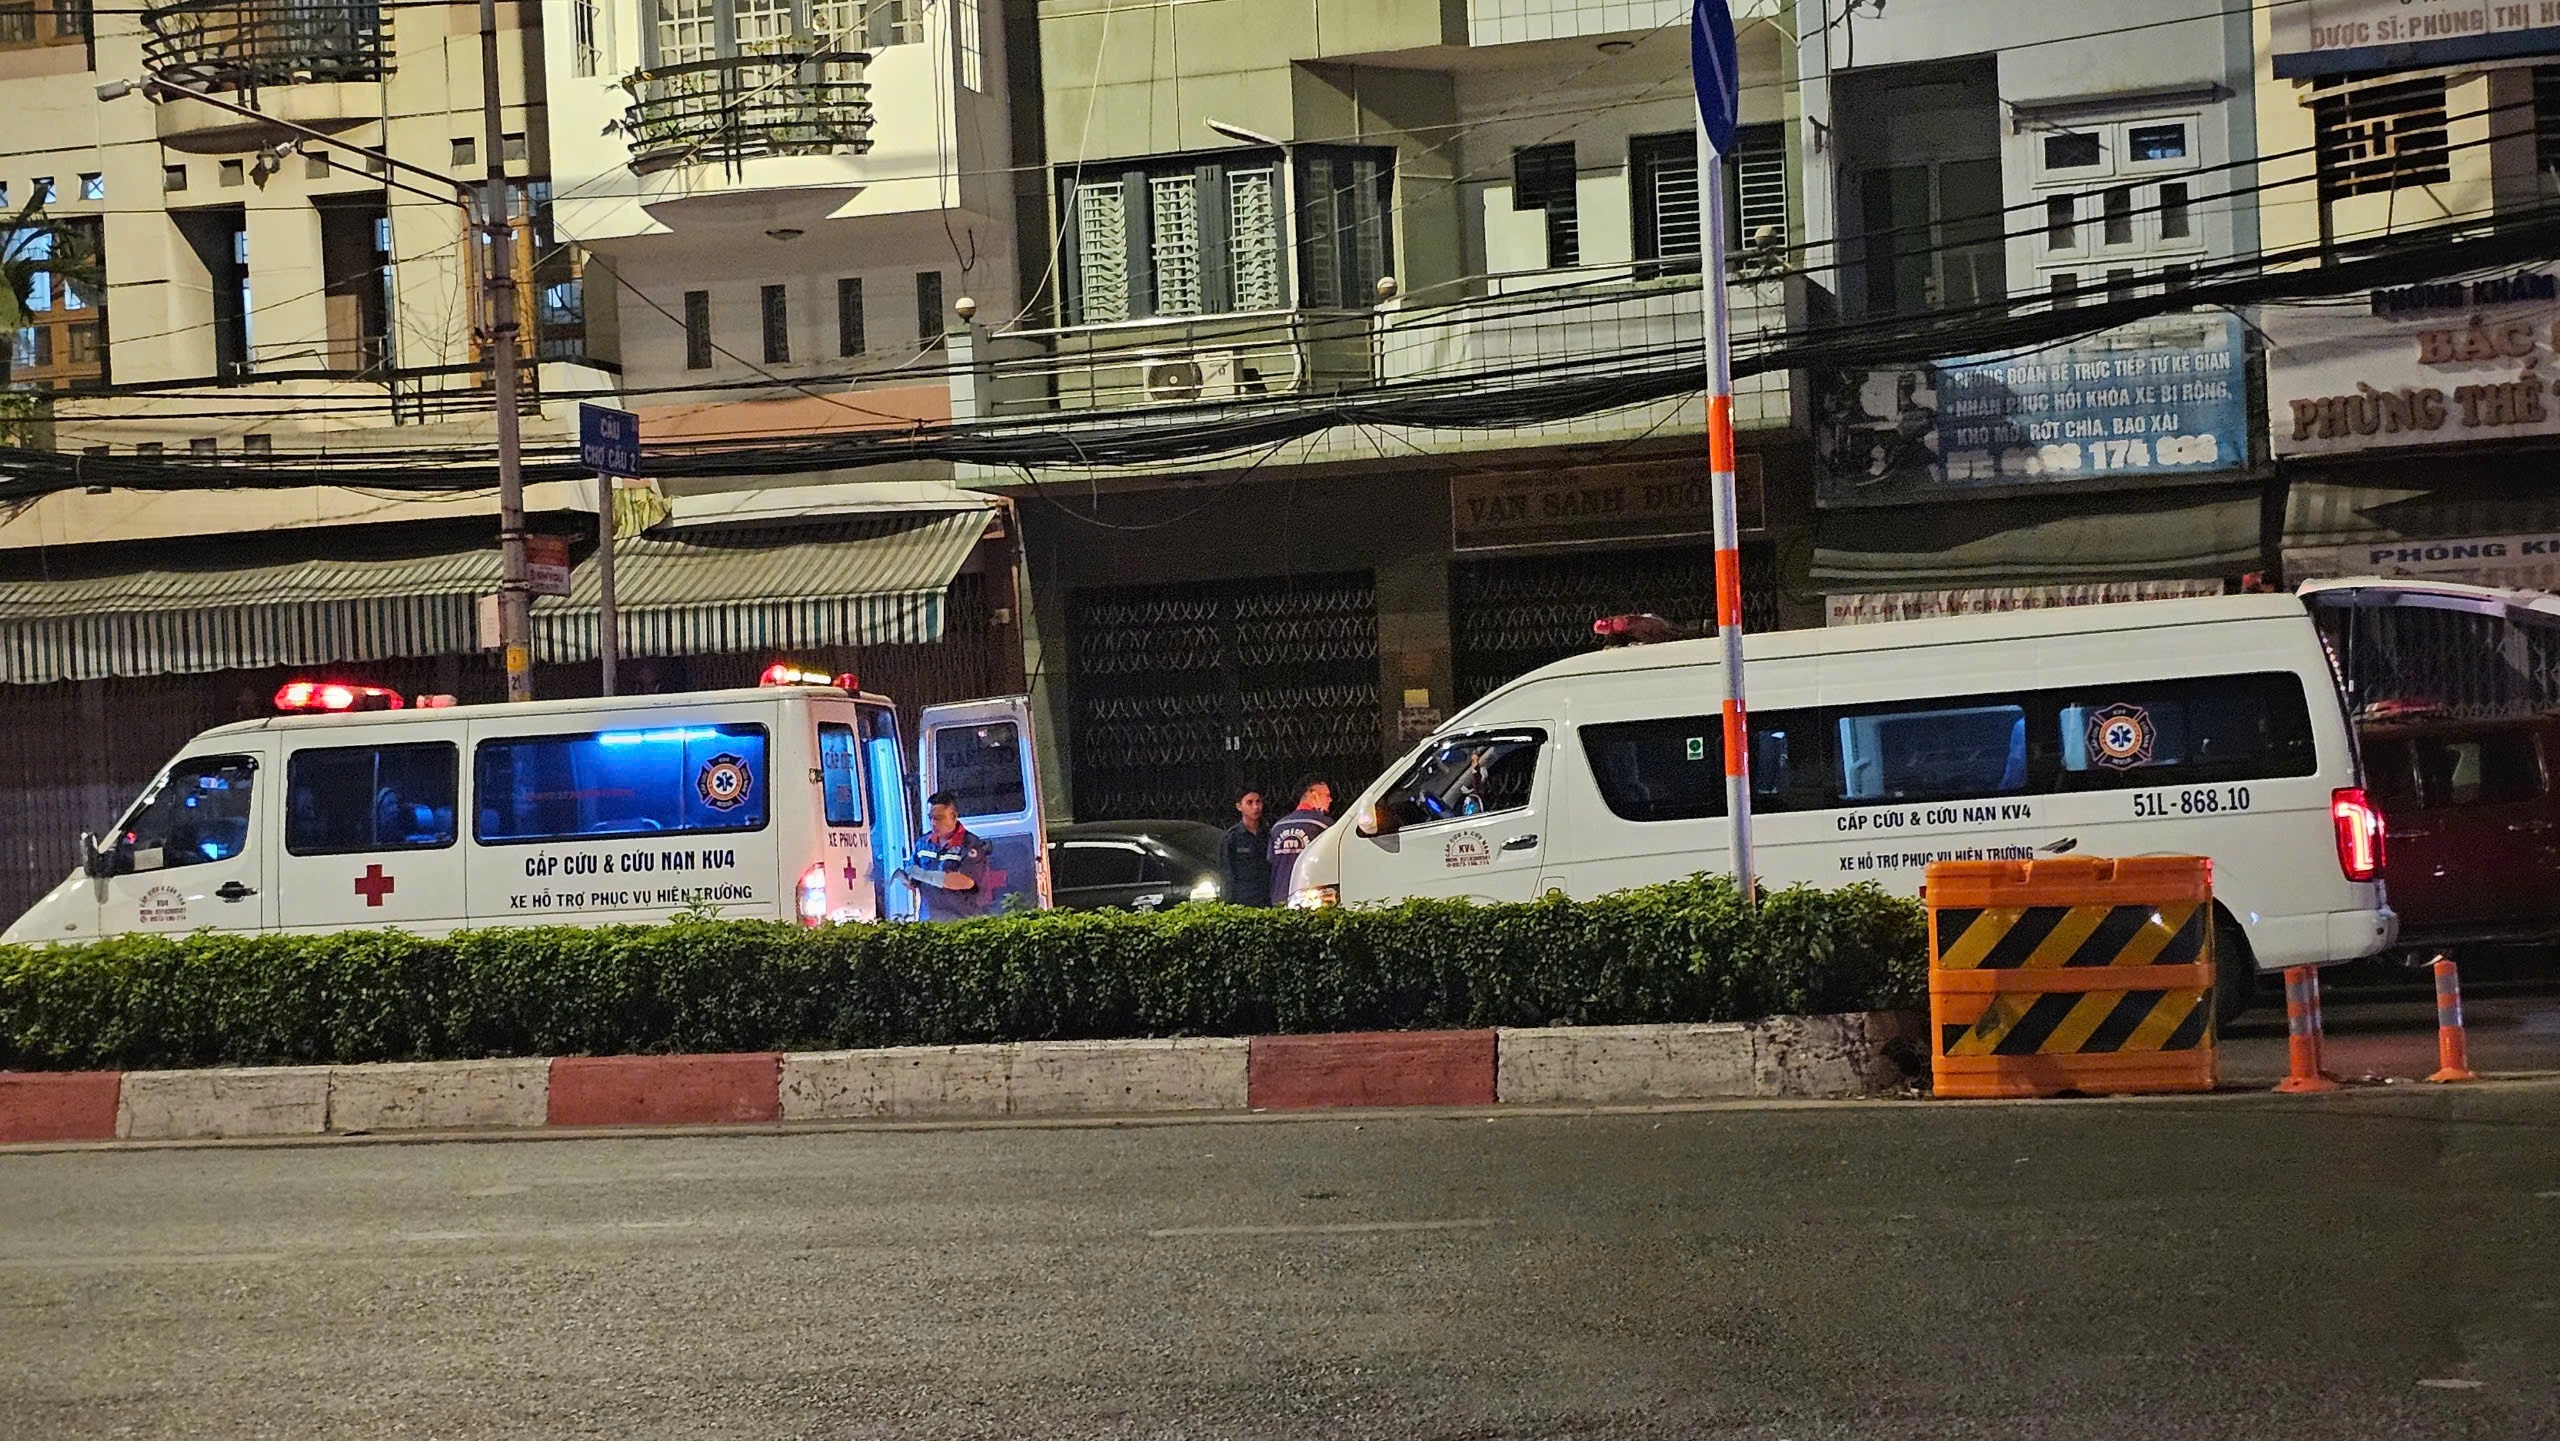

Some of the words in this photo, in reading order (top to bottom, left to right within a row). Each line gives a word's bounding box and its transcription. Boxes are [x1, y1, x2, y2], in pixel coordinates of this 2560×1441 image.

[2417, 314, 2535, 365] BÁC
[2195, 351, 2231, 372] GIAN
[2135, 386, 2156, 404] XE
[2290, 381, 2447, 441] PHÙNG
[2454, 356, 2547, 427] THẾ
[2112, 415, 2146, 435] BAO
[630, 453, 636, 472] 2
[2370, 543, 2507, 565] PHÒNG
[2133, 786, 2250, 817] 51L-868.10
[1837, 809, 1867, 831] CẤP
[1873, 809, 1904, 829] CỨU
[1910, 811, 1921, 826] &
[1927, 806, 1958, 825] CỨU
[1963, 806, 1996, 826] NẠN
[2001, 803, 2032, 821] KV4
[828, 832, 837, 847] XE
[525, 850, 558, 877] CẤP
[564, 851, 597, 875] CỨU
[603, 854, 614, 873] &
[621, 849, 654, 872] CỨU
[661, 850, 695, 875] NẠN
[1840, 857, 1854, 871] XE
[1876, 853, 1899, 871] TRỢ
[510, 895, 527, 909] XE
[533, 888, 550, 907] HỖ
[556, 891, 585, 910] TRỢ
[591, 891, 628, 908] PHỤC
[633, 890, 651, 906] VỤ
[657, 886, 690, 906] HIỆN
[694, 882, 753, 901] TRƯỜNG
